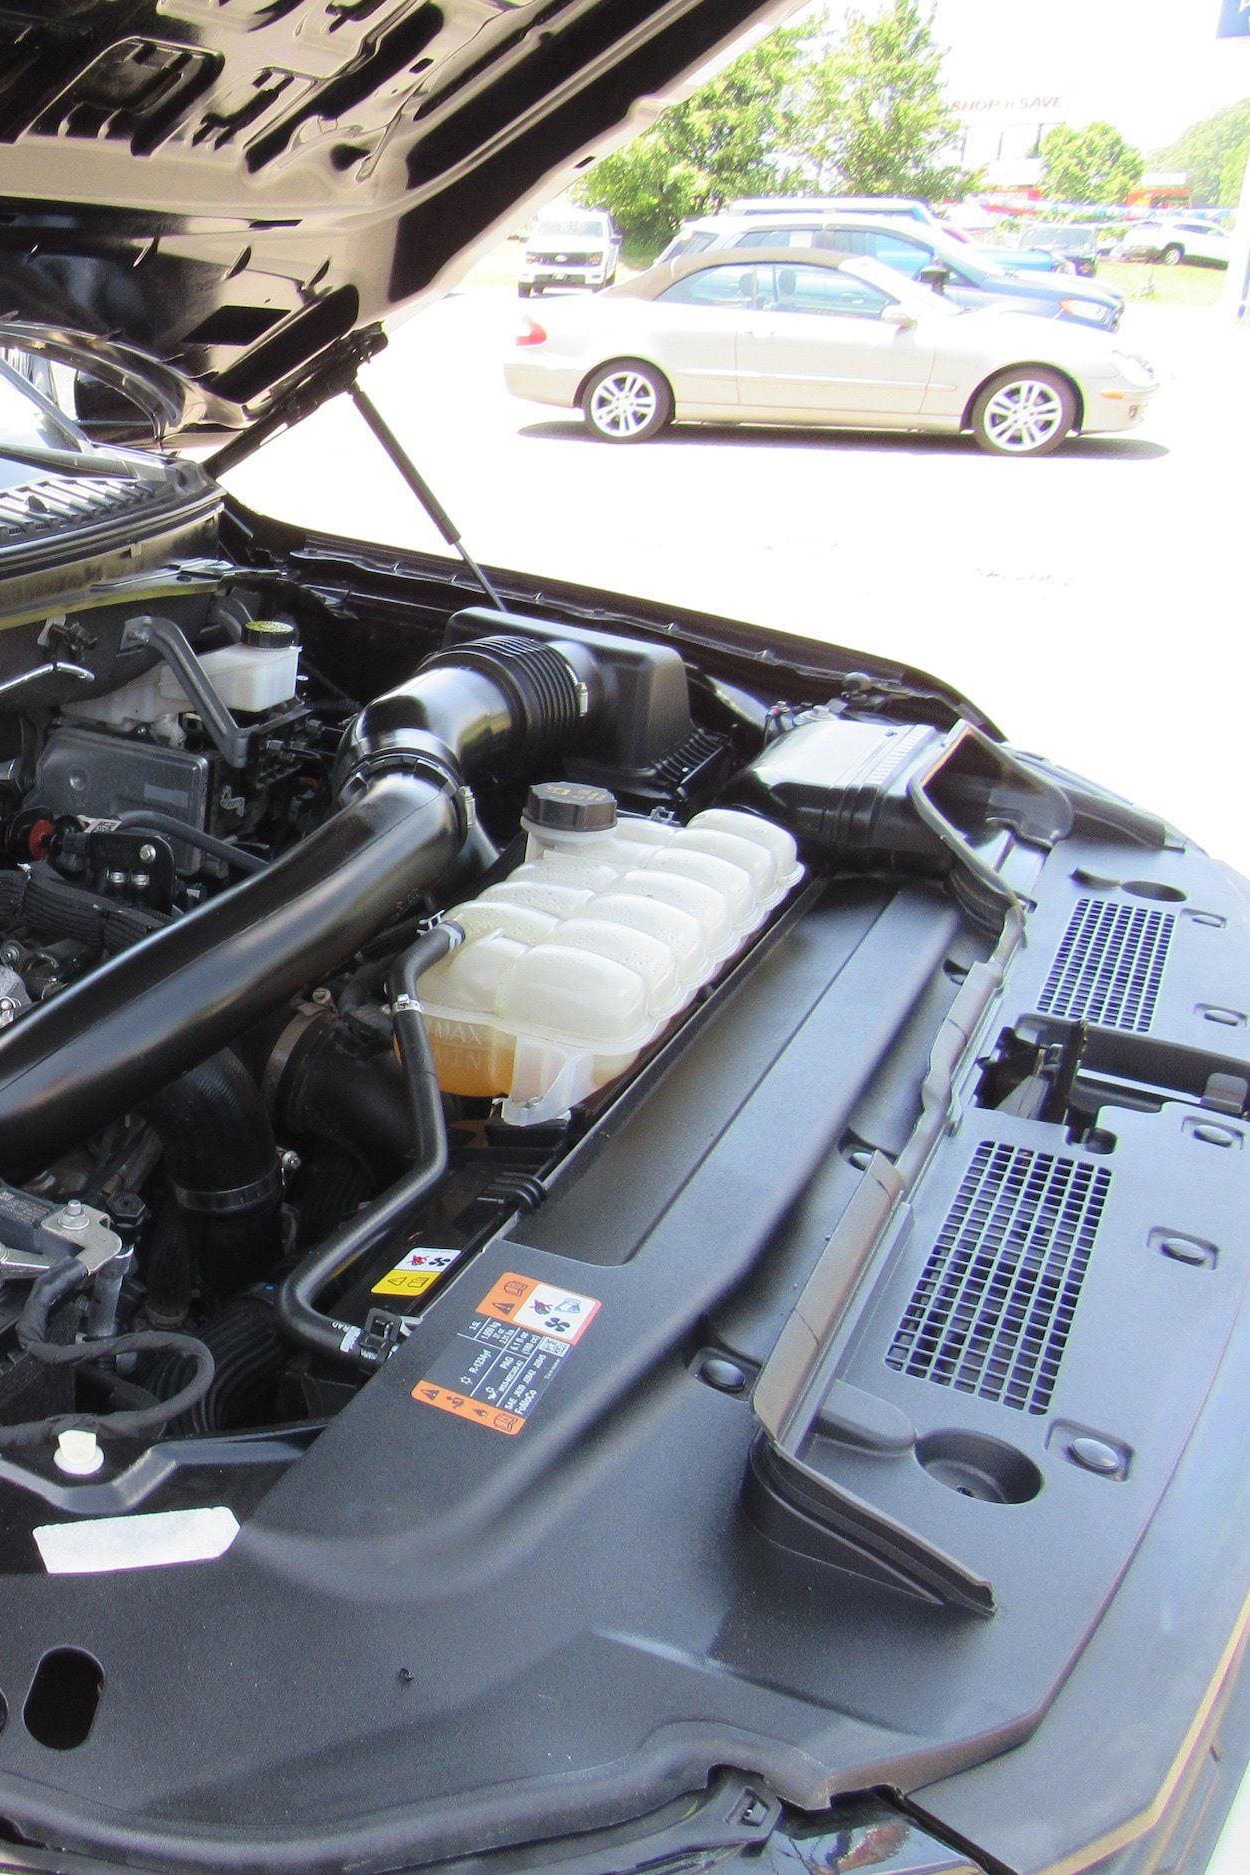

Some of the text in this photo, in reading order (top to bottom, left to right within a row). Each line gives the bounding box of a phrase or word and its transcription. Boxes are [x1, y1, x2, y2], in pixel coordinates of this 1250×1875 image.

[1018, 96, 1063, 109] SAVE
[500, 1356, 514, 1370] PAG
[504, 1397, 517, 1410] SAE
[514, 1389, 537, 1415] FoMoCo
